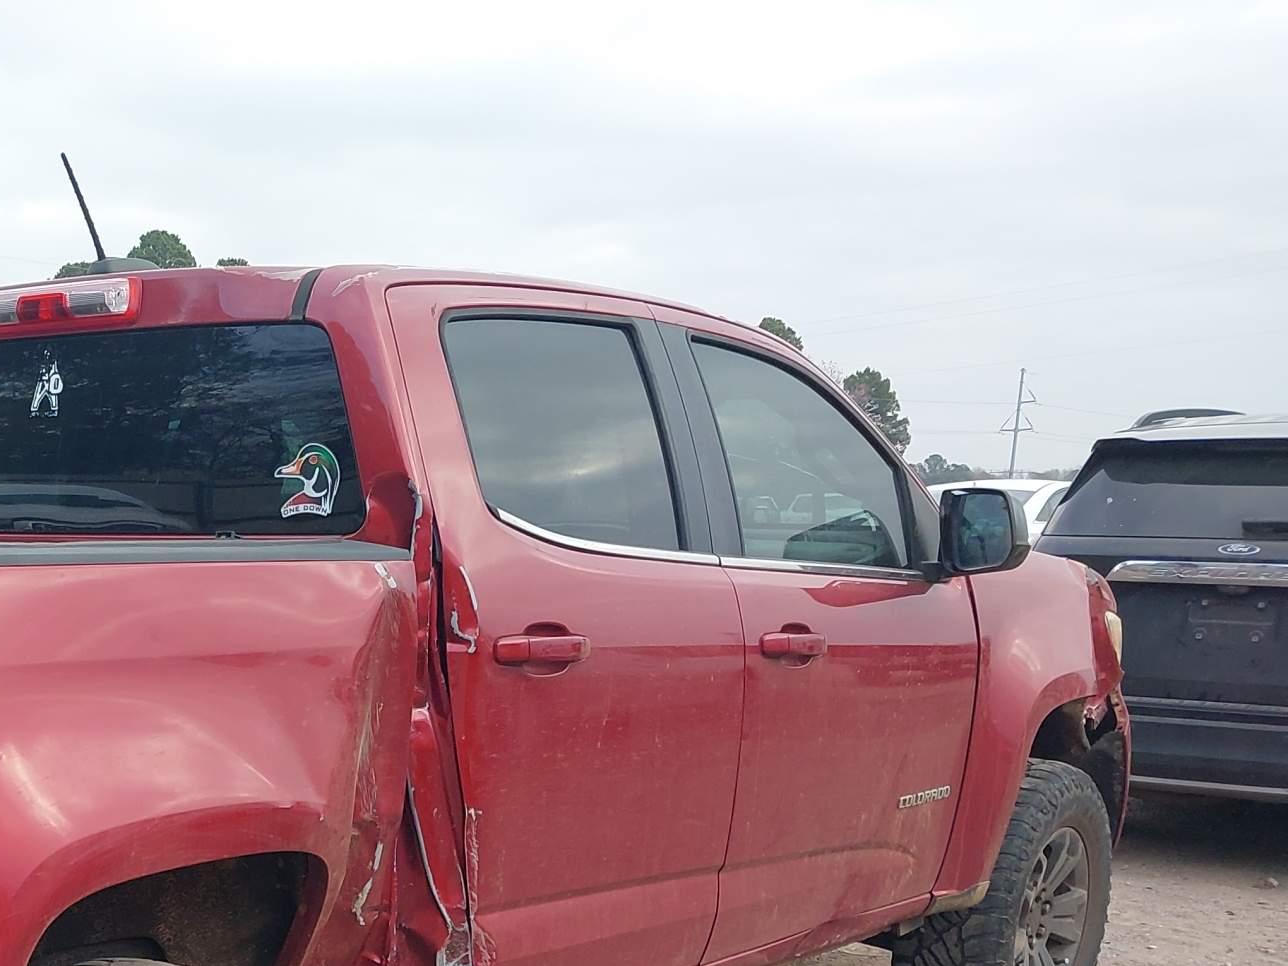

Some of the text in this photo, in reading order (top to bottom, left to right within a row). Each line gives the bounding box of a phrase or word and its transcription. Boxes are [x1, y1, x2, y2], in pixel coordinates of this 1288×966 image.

[283, 505, 328, 516] ONE DOWN
[899, 785, 951, 809] COLORADO
